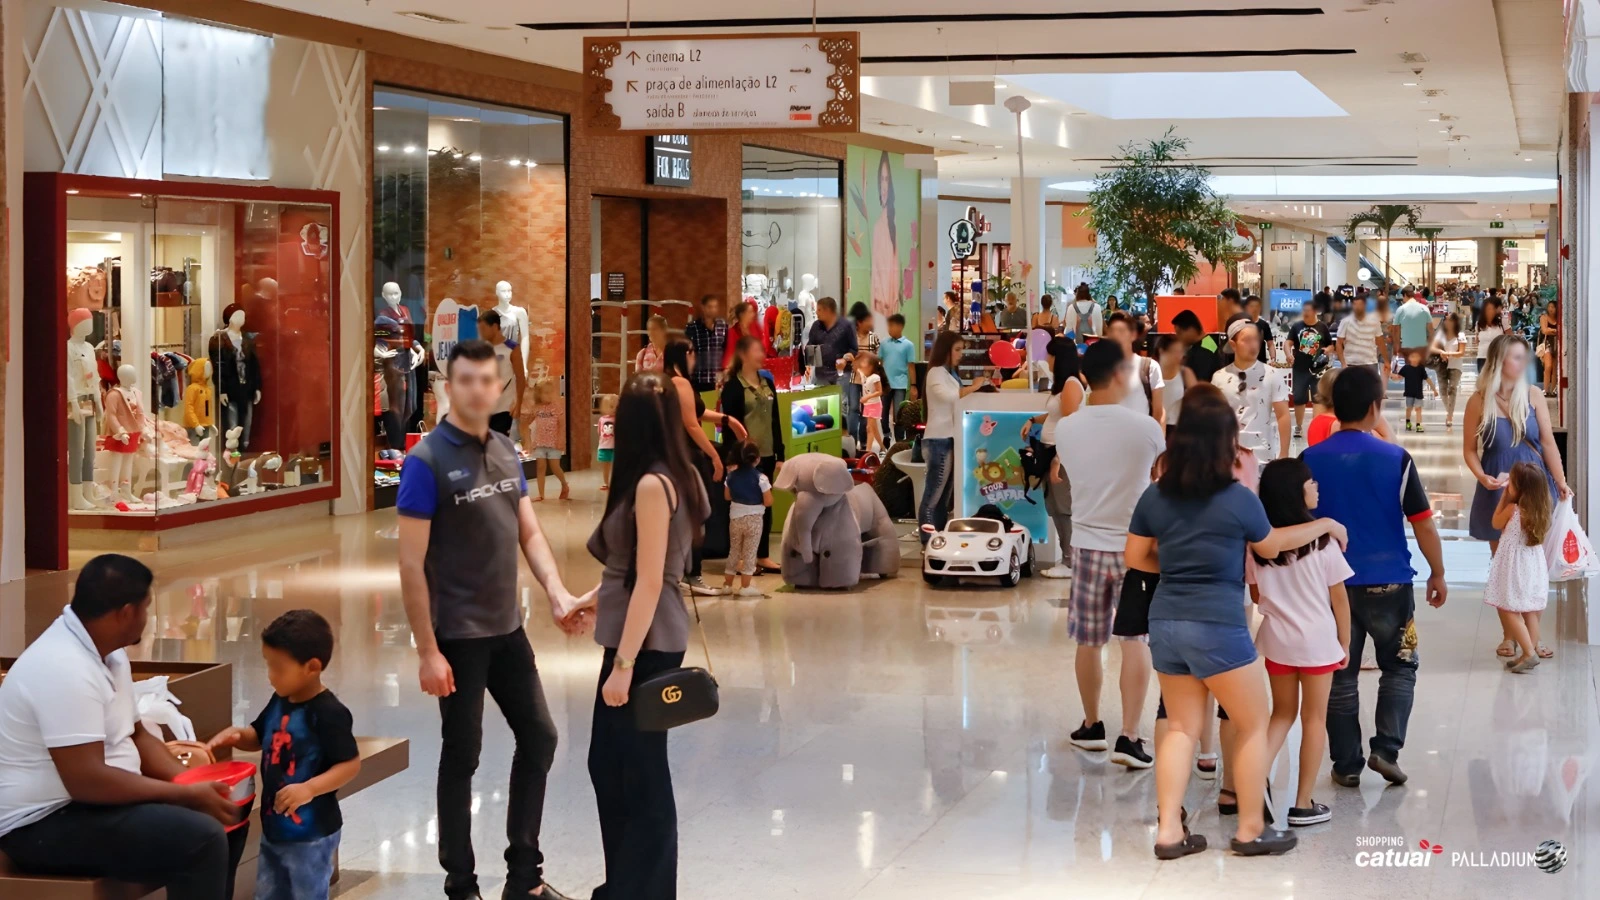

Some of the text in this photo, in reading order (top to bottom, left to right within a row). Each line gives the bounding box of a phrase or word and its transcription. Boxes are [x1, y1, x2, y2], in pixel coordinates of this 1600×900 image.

[646, 49, 701, 63] cinema L2
[646, 75, 777, 94] praça de alimentação L2
[646, 101, 685, 118] saída B
[983, 482, 1004, 494] TOUR
[986, 489, 1027, 503] SAFAR
